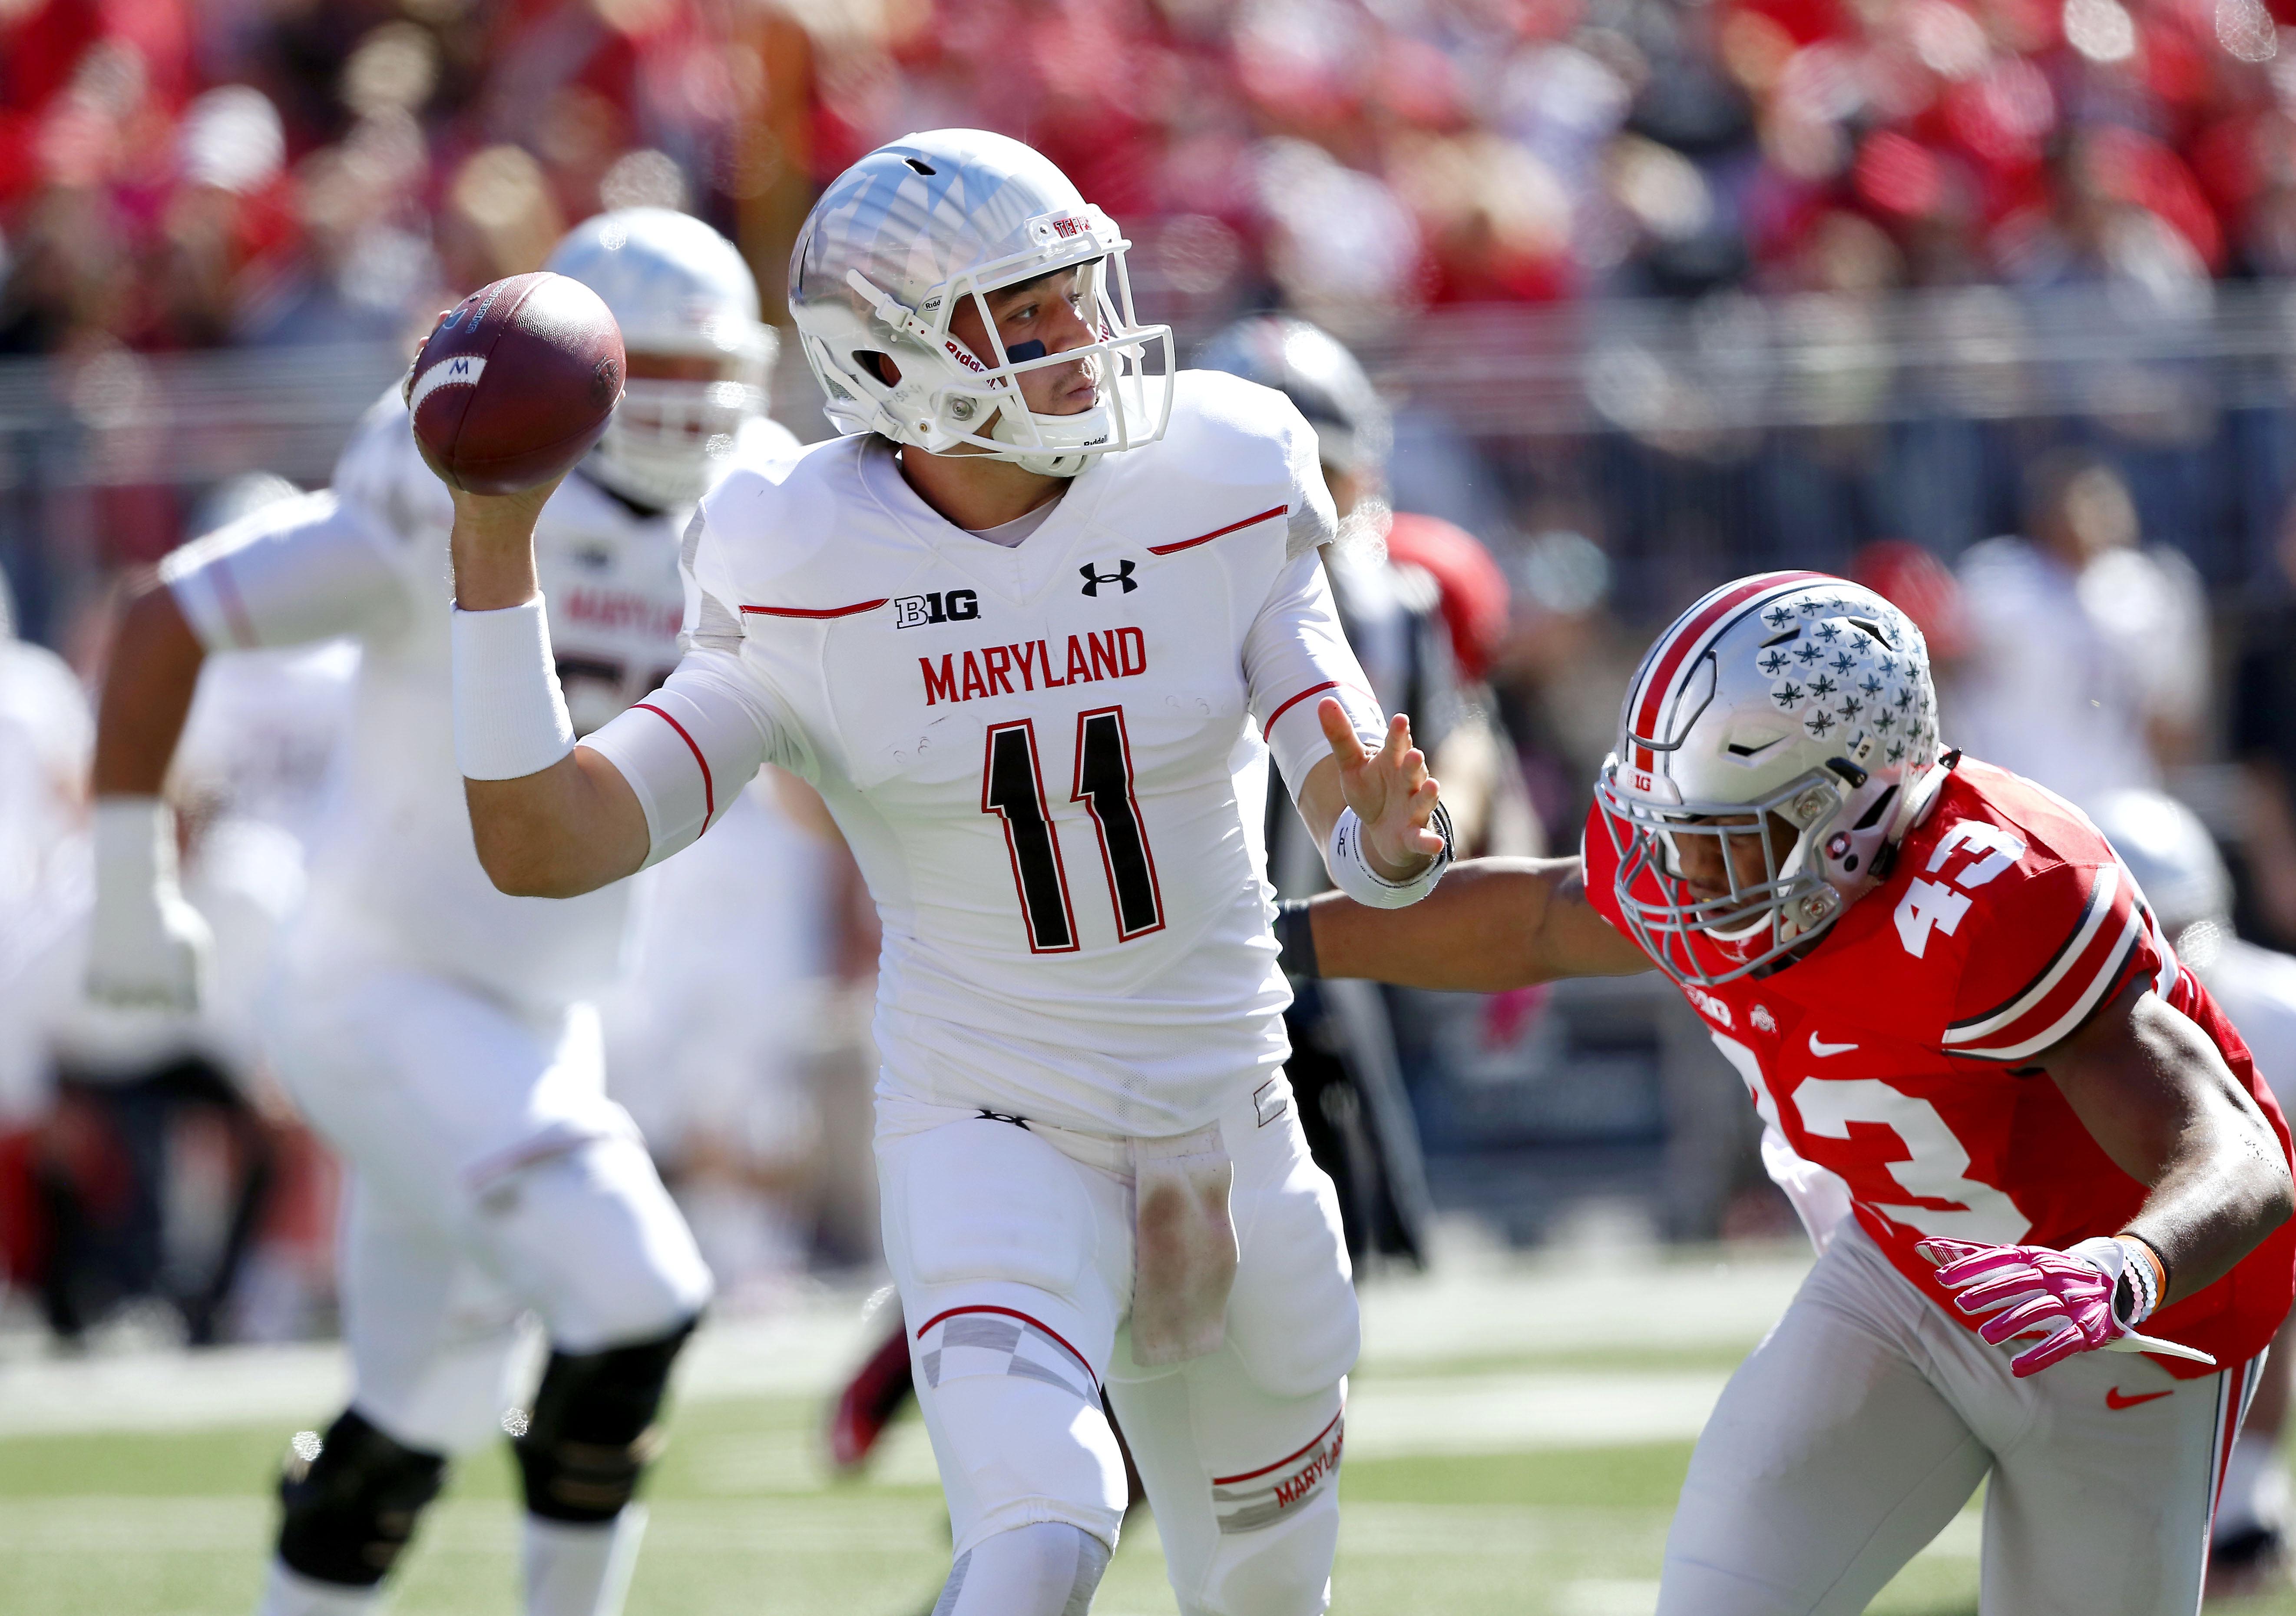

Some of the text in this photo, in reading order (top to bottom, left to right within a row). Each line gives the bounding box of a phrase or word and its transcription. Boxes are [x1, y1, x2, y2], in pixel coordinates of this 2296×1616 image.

[466, 298, 495, 333] UNDER
[918, 626, 1147, 706] MARYLAND
[982, 704, 1166, 954] 11
[1894, 820, 2027, 959] 43
